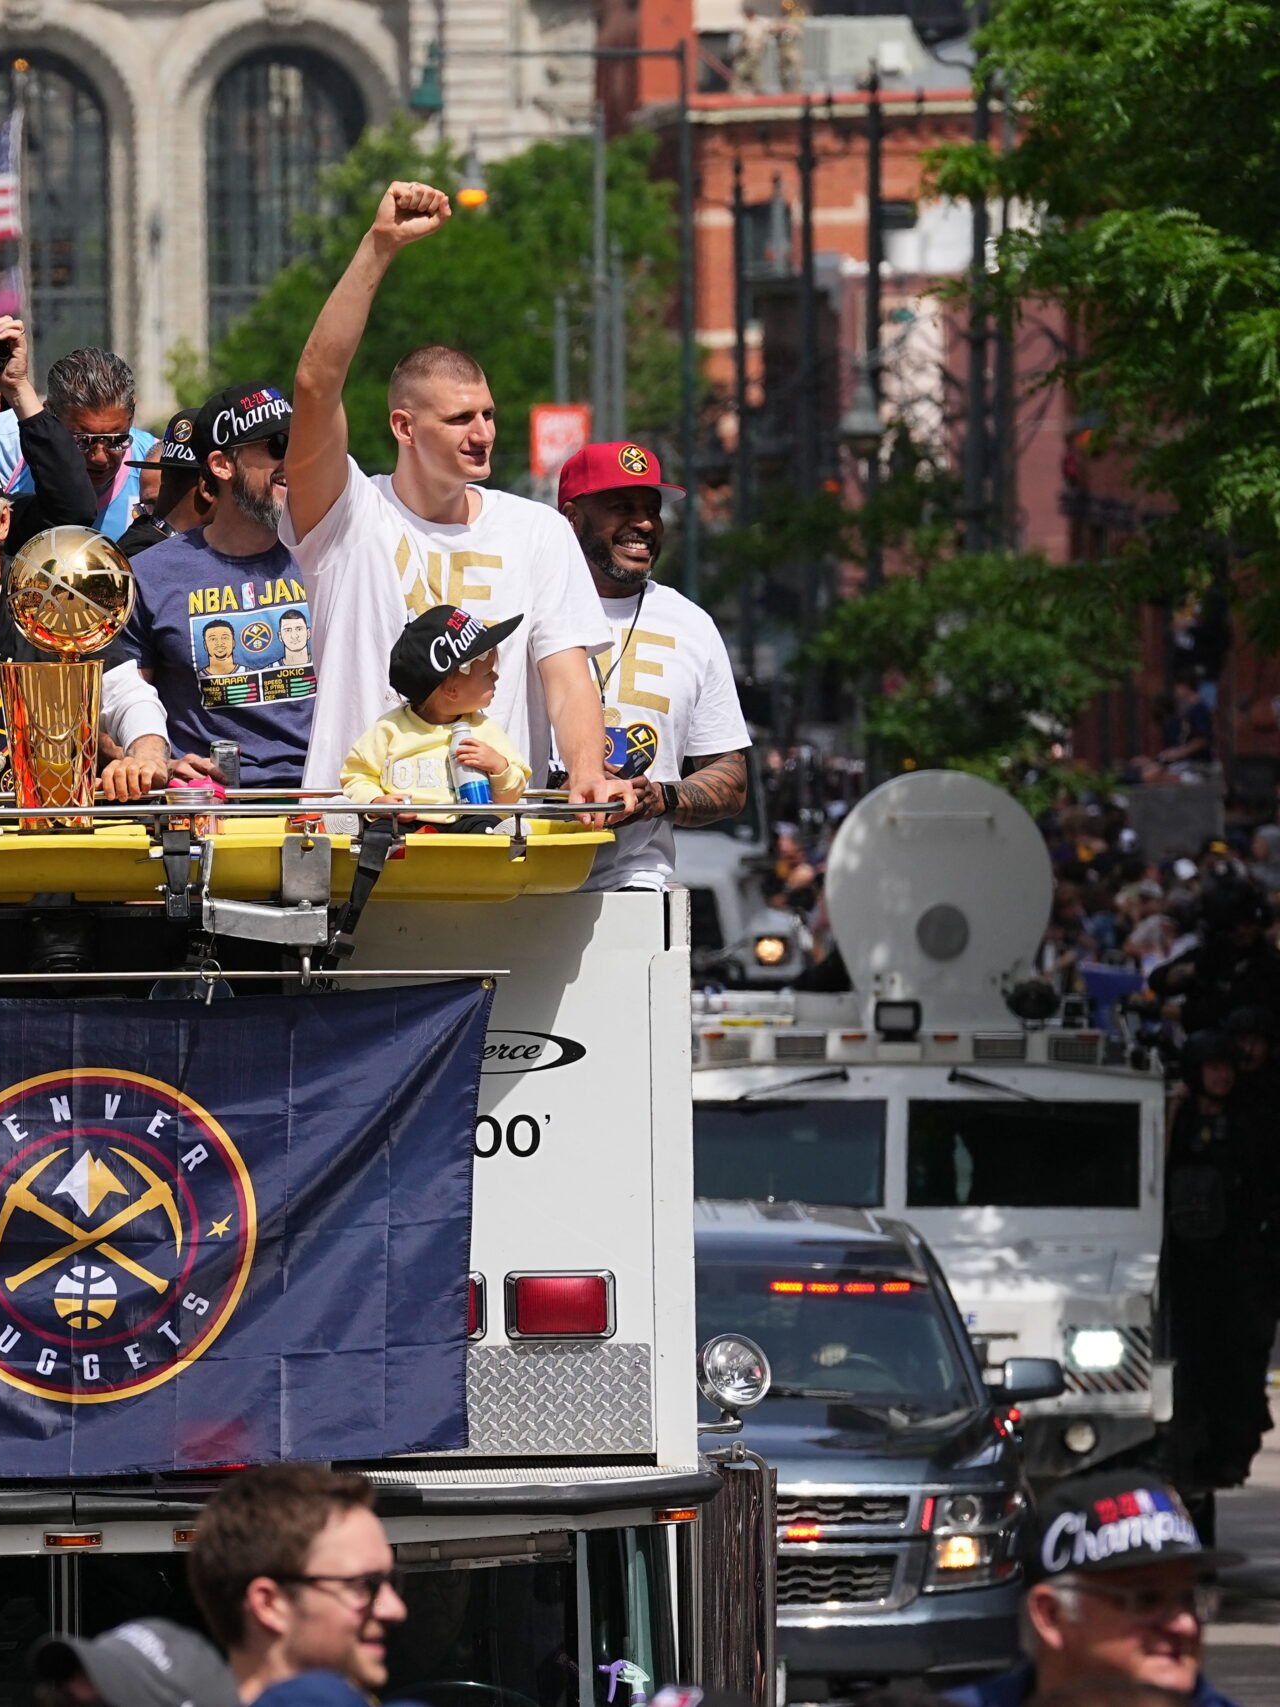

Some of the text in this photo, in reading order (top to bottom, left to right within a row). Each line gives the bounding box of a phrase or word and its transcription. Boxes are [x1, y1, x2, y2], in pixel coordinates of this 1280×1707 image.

[189, 585, 239, 615] NBA
[277, 668, 305, 678] JOKIC
[483, 1043, 542, 1060] erce
